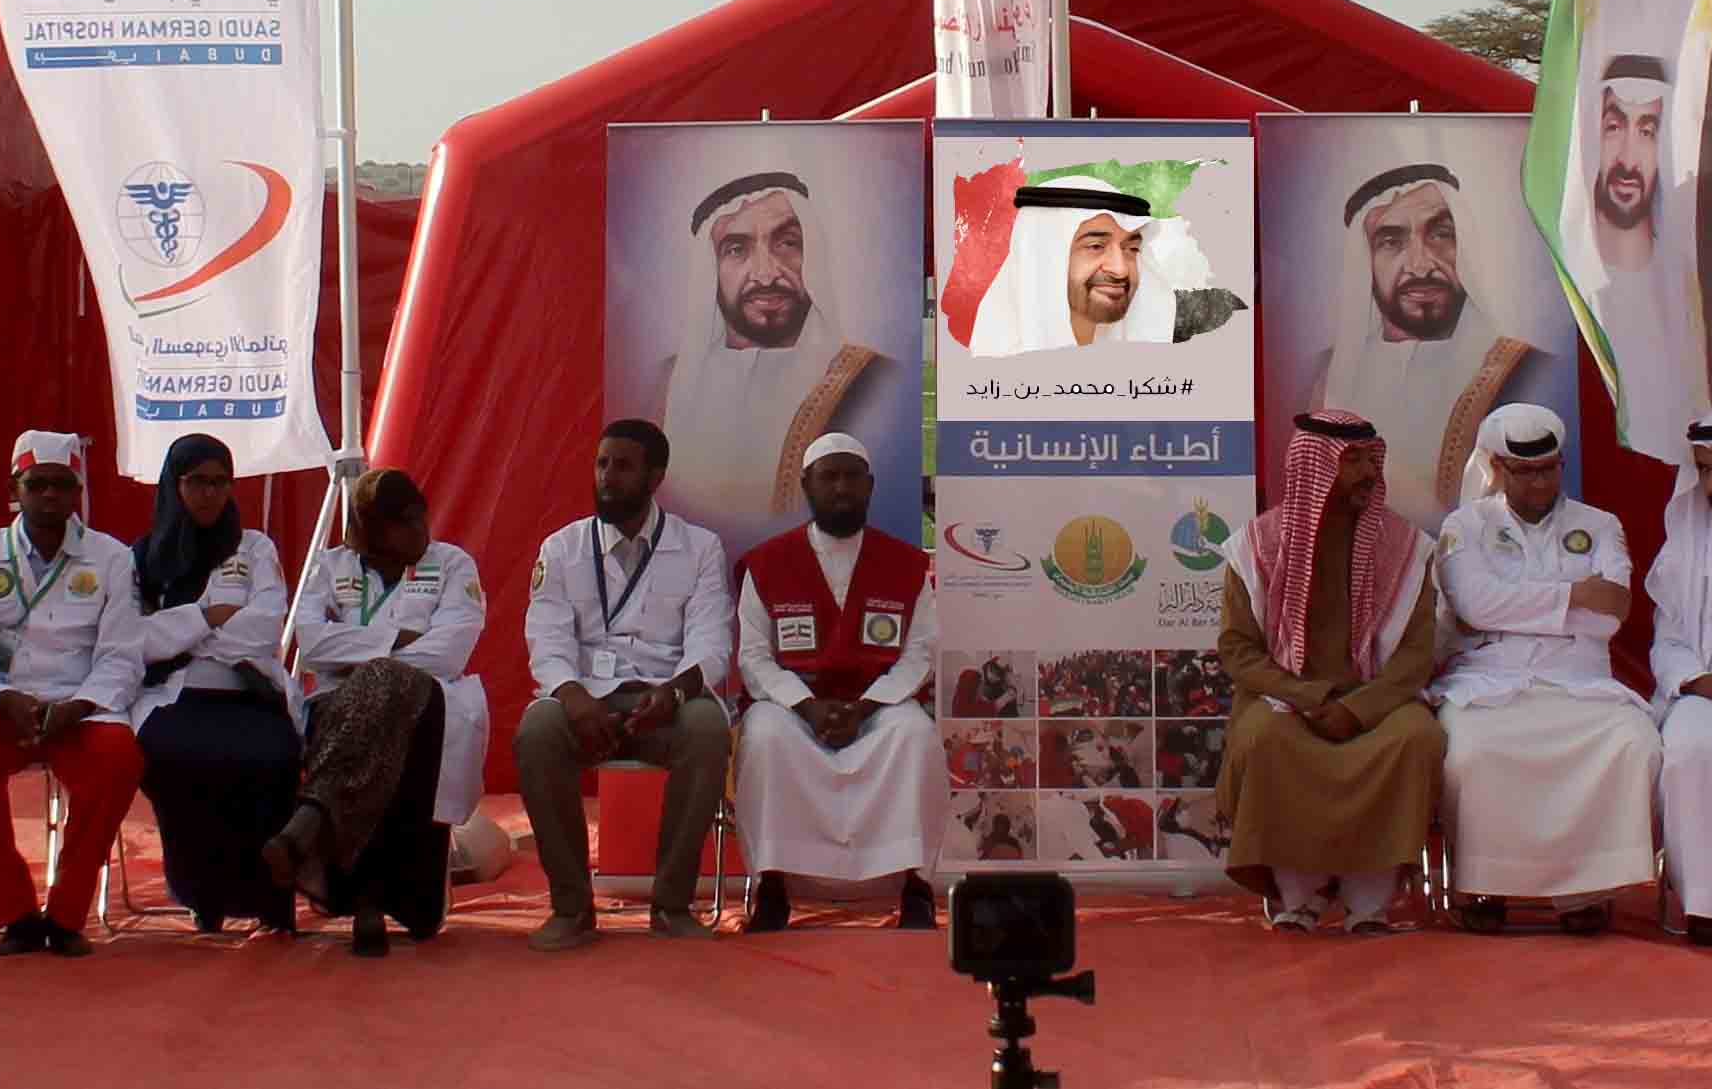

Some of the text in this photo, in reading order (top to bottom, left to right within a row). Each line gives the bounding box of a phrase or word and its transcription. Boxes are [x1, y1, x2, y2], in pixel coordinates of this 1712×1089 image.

[965, 377, 1195, 400] #شكرا_محمد_بن_زايد
[969, 425, 1222, 470] أطباء الإنسانية
